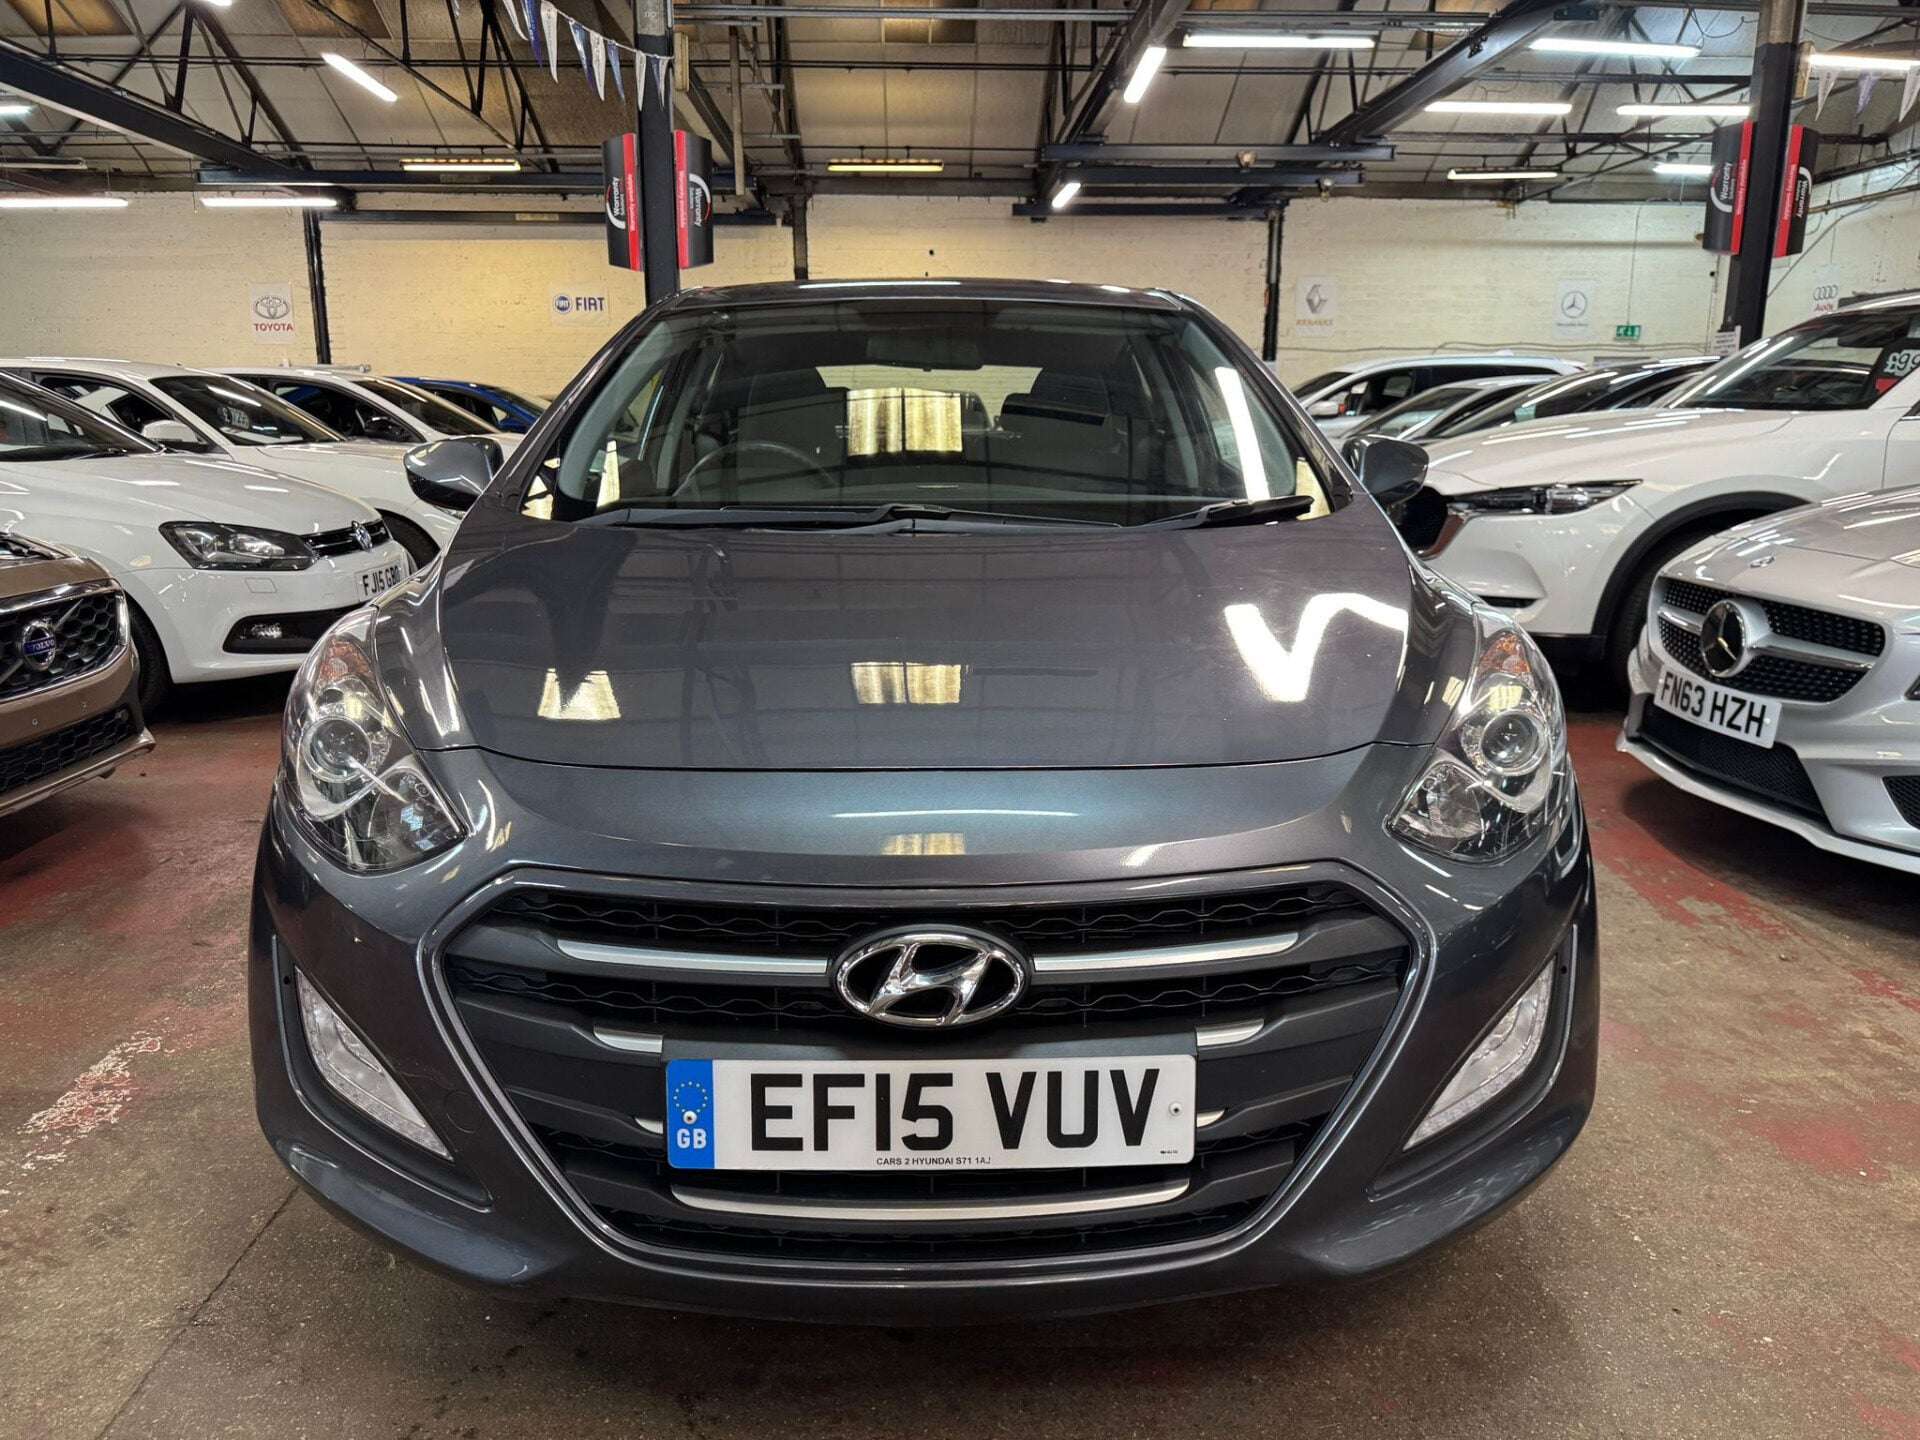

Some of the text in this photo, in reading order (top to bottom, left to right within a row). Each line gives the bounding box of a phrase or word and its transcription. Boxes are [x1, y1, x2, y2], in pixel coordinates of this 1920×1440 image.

[1720, 162, 1732, 200] Warranty
[694, 187, 702, 227] Warranty
[1796, 180, 1808, 218] Warranty
[575, 296, 605, 311] FIAT
[254, 322, 294, 331] TOYOTA
[362, 570, 386, 596] FJ15
[1660, 671, 1767, 738] FN63 HZH
[750, 1068, 1161, 1152] EF15 VUV
[676, 1128, 707, 1149] GB
[876, 1157, 902, 1165] CARS
[904, 1157, 910, 1165] 2
[912, 1157, 954, 1165] HYUNDAI
[956, 1157, 972, 1165] S71
